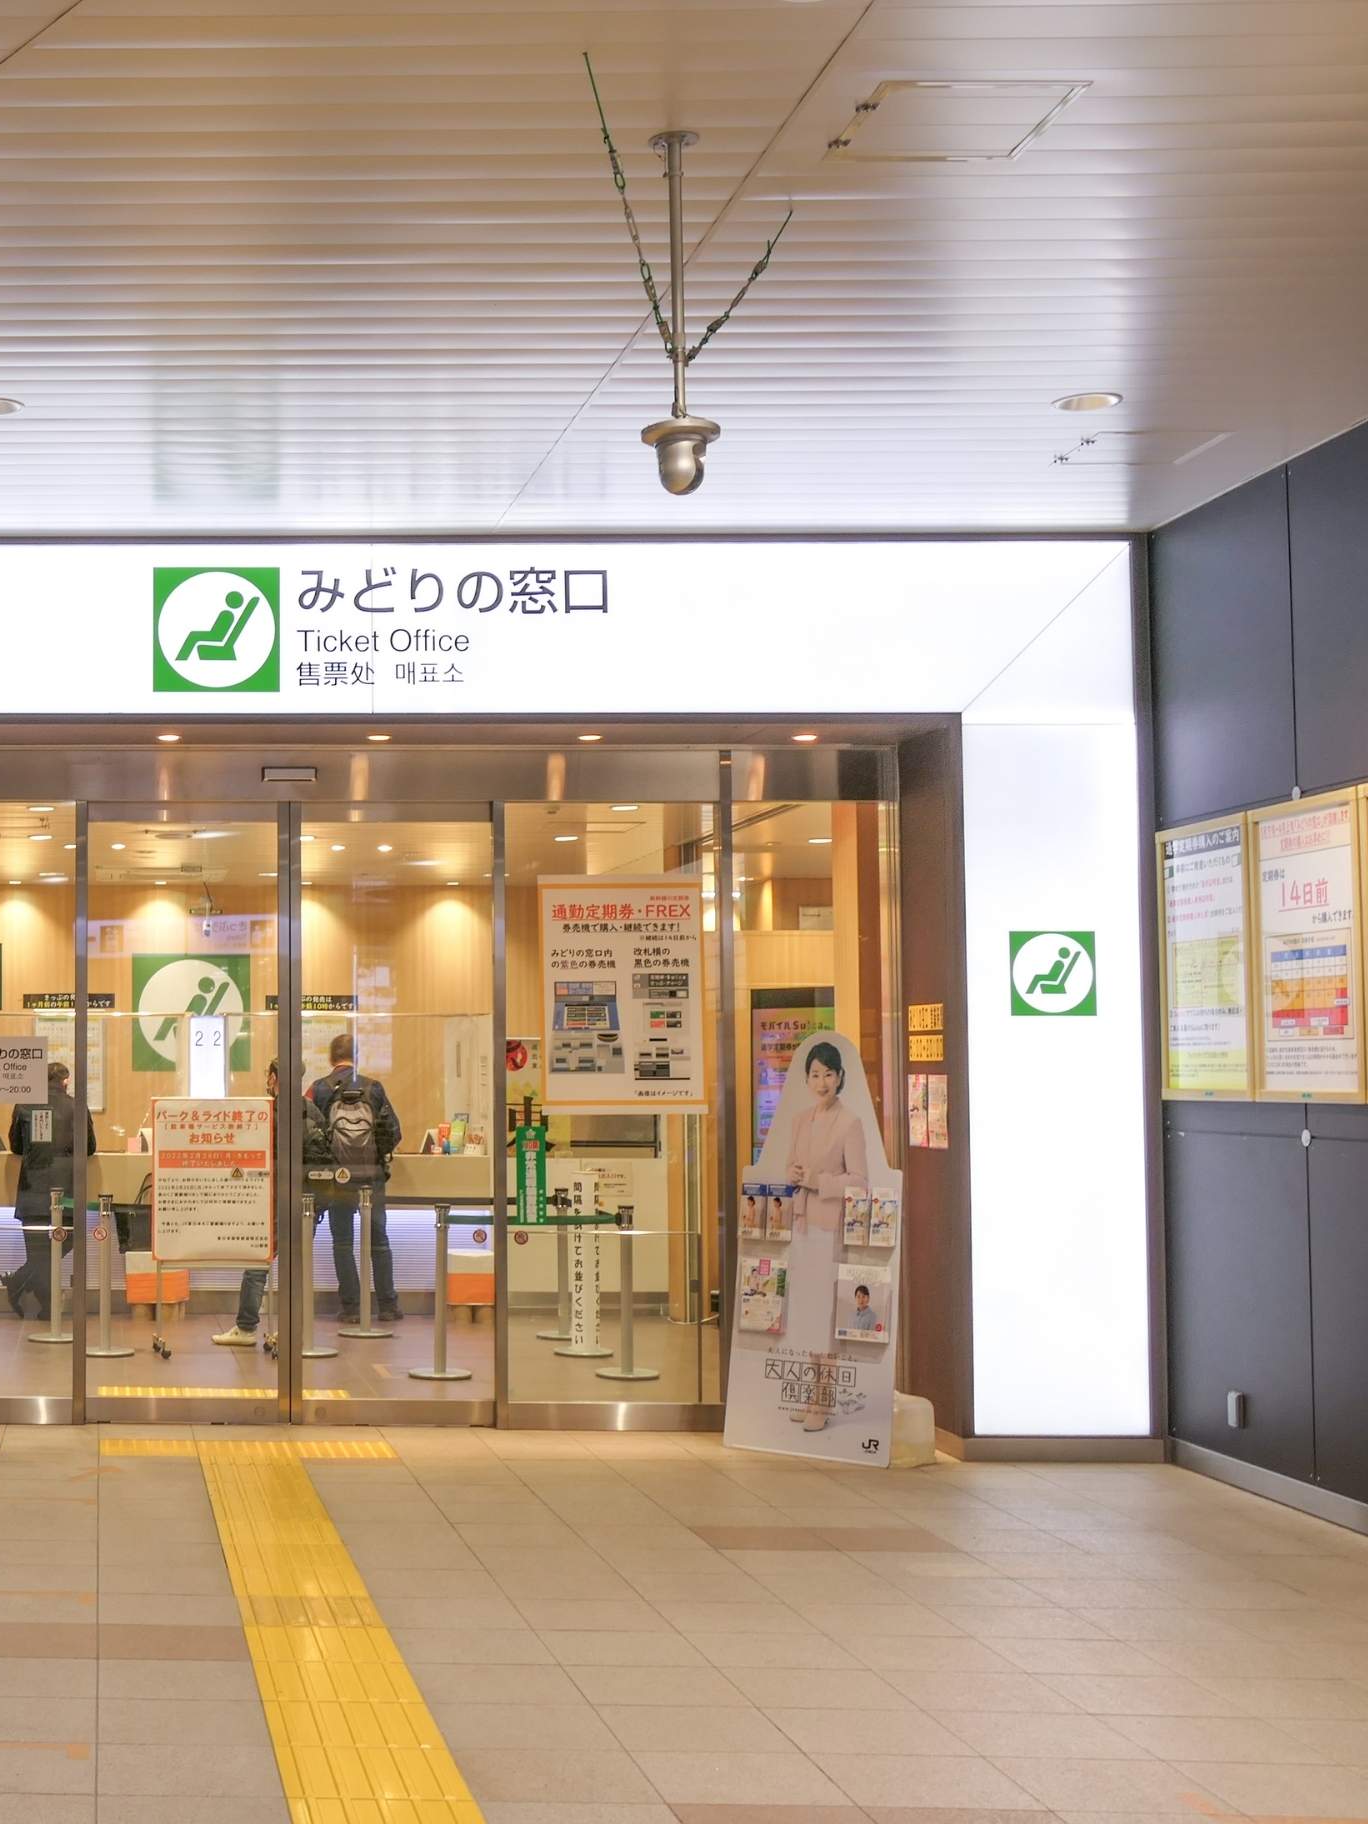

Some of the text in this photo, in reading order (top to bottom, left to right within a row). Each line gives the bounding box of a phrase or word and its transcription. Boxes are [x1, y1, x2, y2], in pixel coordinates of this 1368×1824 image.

[297, 566, 609, 615] みどりの窓口
[296, 628, 470, 653] Ticket Office
[296, 661, 376, 687] 售票处
[394, 662, 465, 686] 매표소
[1281, 877, 1329, 908] 14日前
[551, 948, 613, 958] みどりの窓口内
[633, 947, 671, 956] 改札横の
[551, 959, 617, 970] の紫色の券売機
[633, 958, 690, 969] 黒色の券売機
[2, 1062, 28, 1072] Office
[189, 1132, 235, 1145] お知らせ
[765, 1360, 853, 1385] 大人の休日
[782, 1382, 837, 1407] 倶楽部
[861, 1438, 880, 1451] JR
